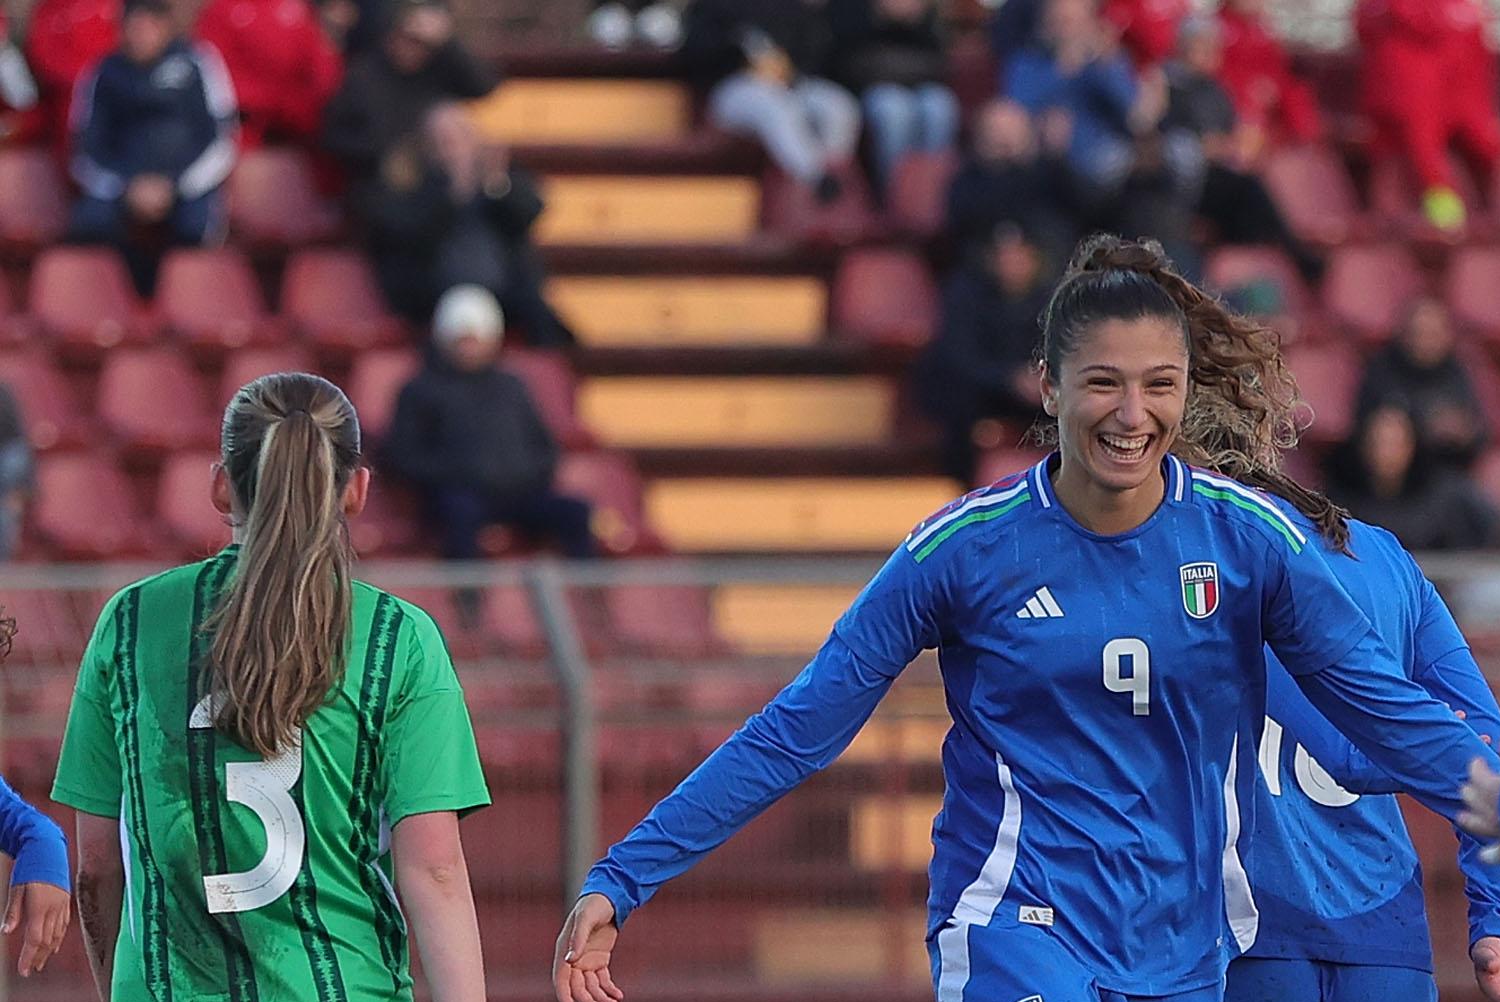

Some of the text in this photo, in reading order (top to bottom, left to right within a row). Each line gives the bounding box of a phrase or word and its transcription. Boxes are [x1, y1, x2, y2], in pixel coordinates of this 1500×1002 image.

[1183, 566, 1215, 580] ITALIA
[1103, 638, 1150, 716] 9
[188, 693, 305, 914] 3
